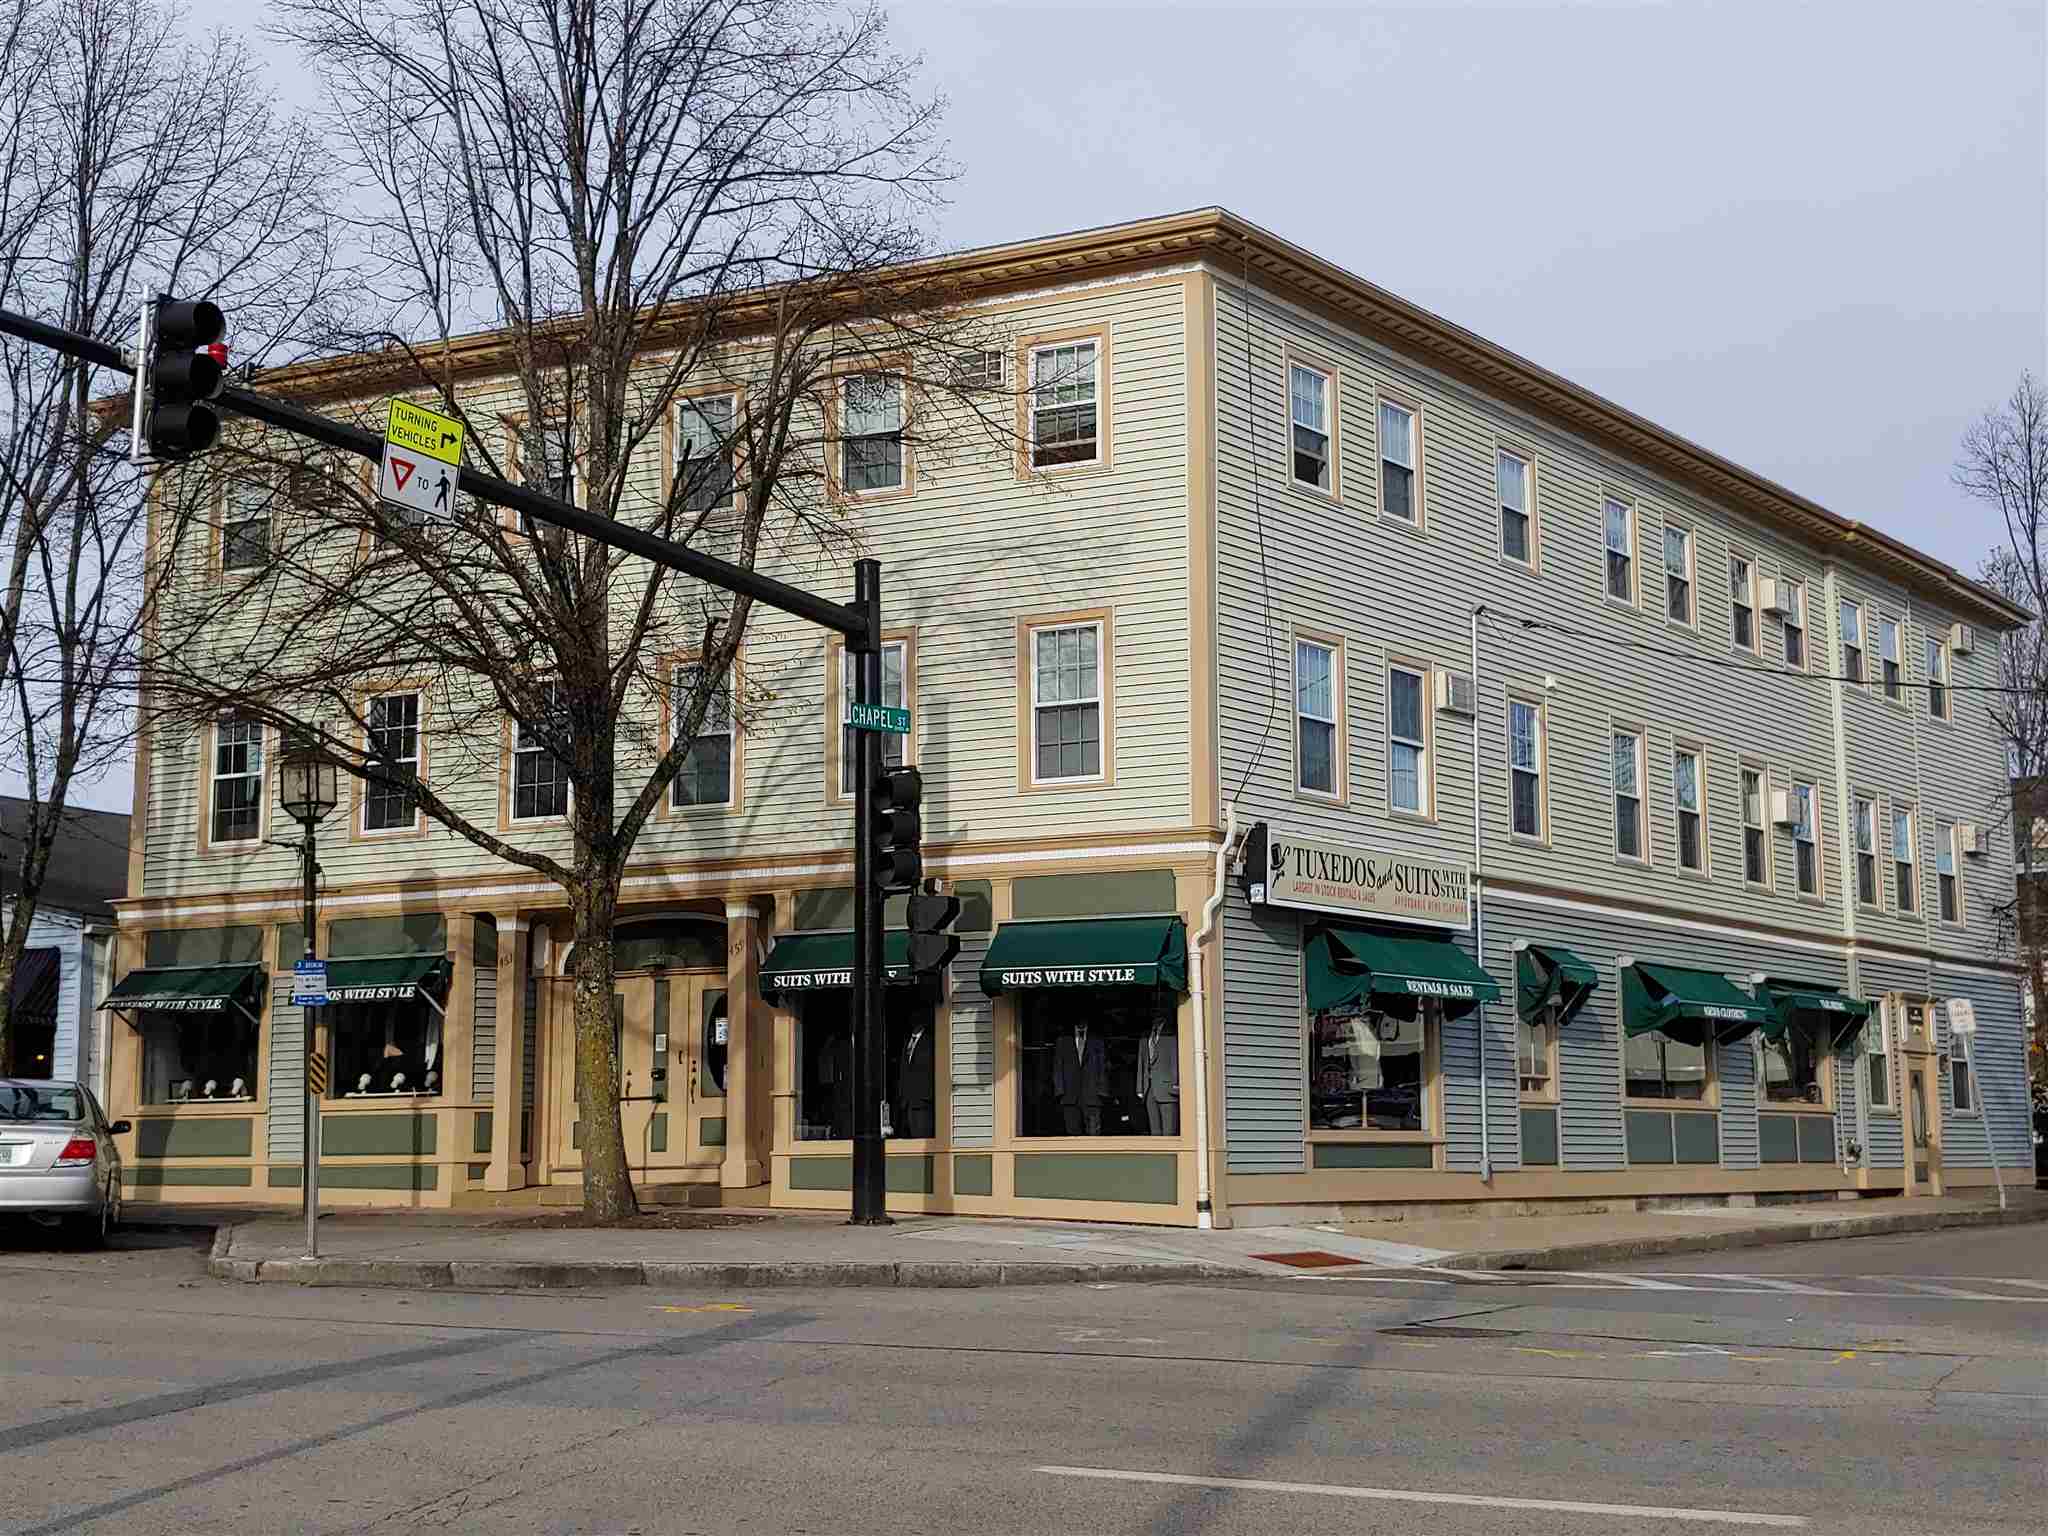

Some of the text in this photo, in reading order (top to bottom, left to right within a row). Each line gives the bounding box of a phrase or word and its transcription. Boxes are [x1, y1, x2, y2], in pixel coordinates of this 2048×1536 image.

[396, 407, 437, 432] TURNING
[392, 424, 437, 450] VEHICLES
[417, 476, 429, 490] TO
[852, 705, 893, 729] CHAPEL
[1293, 847, 1440, 898] TUXEDOS and SUITS
[1442, 869, 1466, 886] WITH
[1440, 884, 1467, 901] STYLE
[773, 971, 851, 987] SUITS WITH
[1001, 967, 1136, 985] SUITS WITH STYLE
[344, 988, 376, 1000] WITH
[377, 986, 416, 999] STYLE
[1406, 979, 1442, 993] RENTALS
[1449, 983, 1473, 997] SALES
[154, 999, 186, 1010] WITH
[186, 998, 223, 1009] STYLE
